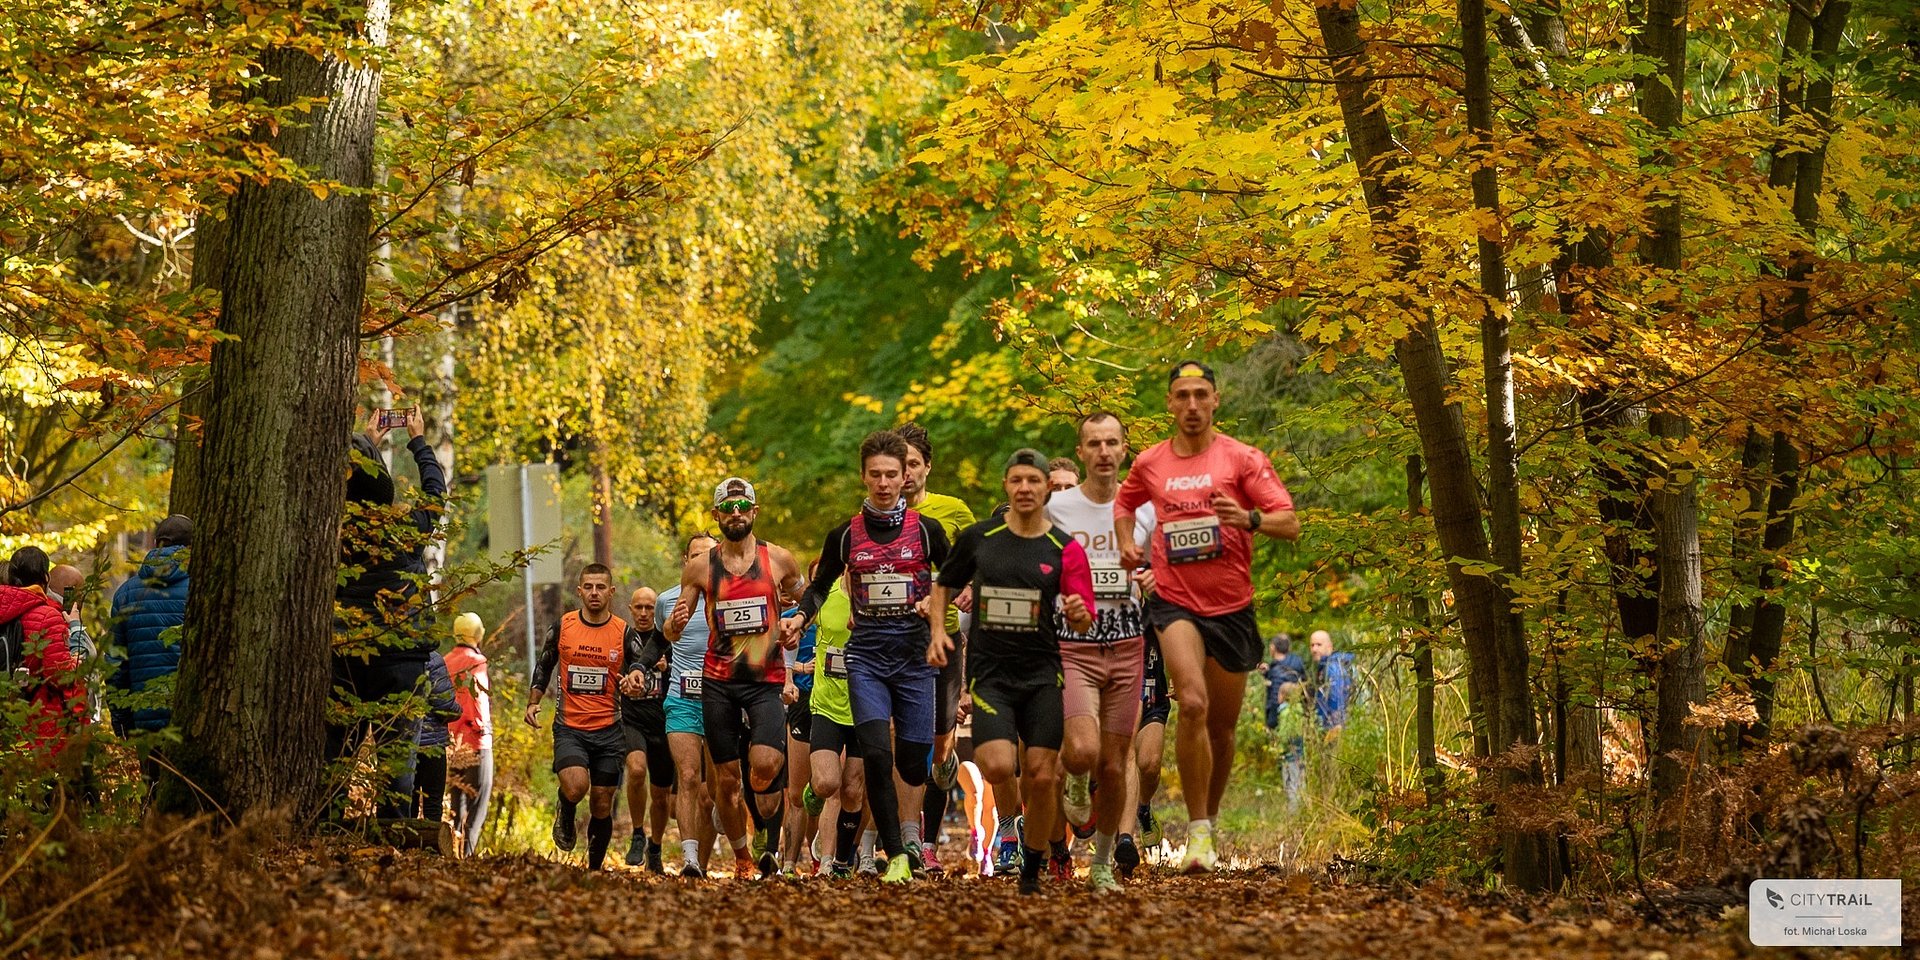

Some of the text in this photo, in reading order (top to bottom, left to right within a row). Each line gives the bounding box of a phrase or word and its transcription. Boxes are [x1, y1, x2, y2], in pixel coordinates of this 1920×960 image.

[1165, 473, 1212, 492] HOKA
[1171, 530, 1211, 548] 1080
[1093, 571, 1119, 584] 139
[881, 585, 893, 597] 4
[1005, 601, 1011, 615] 1
[733, 609, 751, 622] 25
[572, 651, 607, 661] Jaworzno
[578, 674, 597, 685] 123
